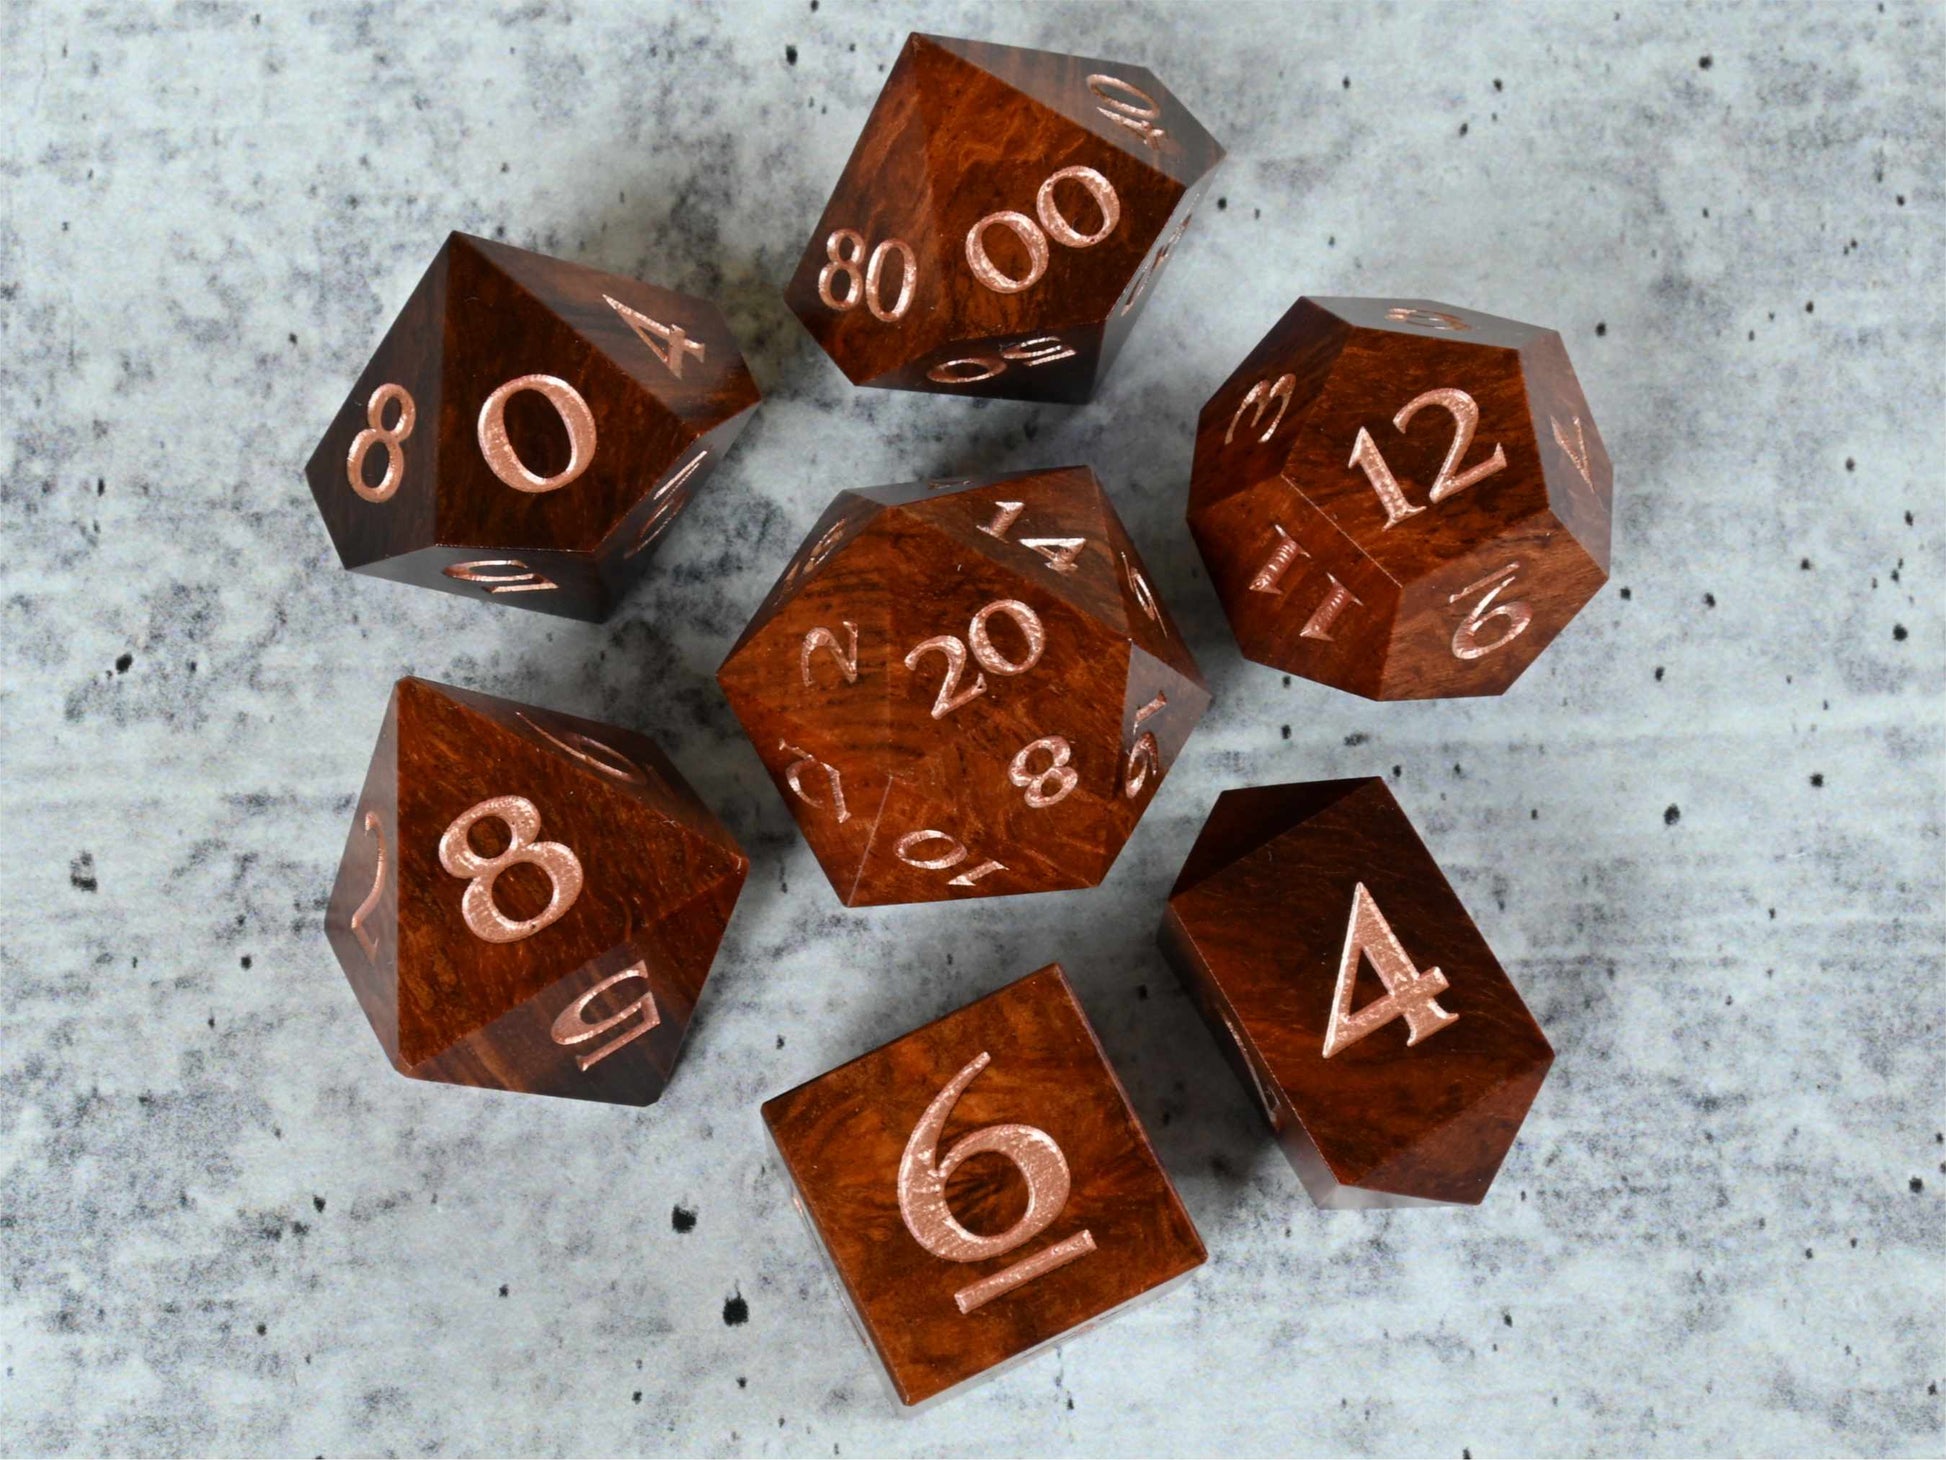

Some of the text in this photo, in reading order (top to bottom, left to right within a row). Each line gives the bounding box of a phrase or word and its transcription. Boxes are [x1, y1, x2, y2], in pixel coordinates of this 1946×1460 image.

[1086, 73, 1166, 150] 40
[818, 228, 917, 322] 80
[965, 165, 1120, 294] 00
[602, 293, 705, 380] 4
[926, 336, 1077, 384] 50
[347, 383, 416, 503] 8
[477, 374, 597, 492] 0
[1224, 373, 1296, 445] 3
[1348, 387, 1507, 530] 12
[443, 559, 559, 594] 5
[976, 501, 1087, 572] 14
[1249, 524, 1364, 642] 11
[801, 621, 858, 687] 2
[904, 599, 1046, 720] 20
[1008, 735, 1078, 809] 8
[351, 810, 387, 965] 2
[438, 795, 584, 943] 8
[893, 829, 1009, 887] 10
[550, 959, 661, 1071] 5
[1322, 881, 1459, 1059] 4
[897, 1051, 1097, 1314] 6
